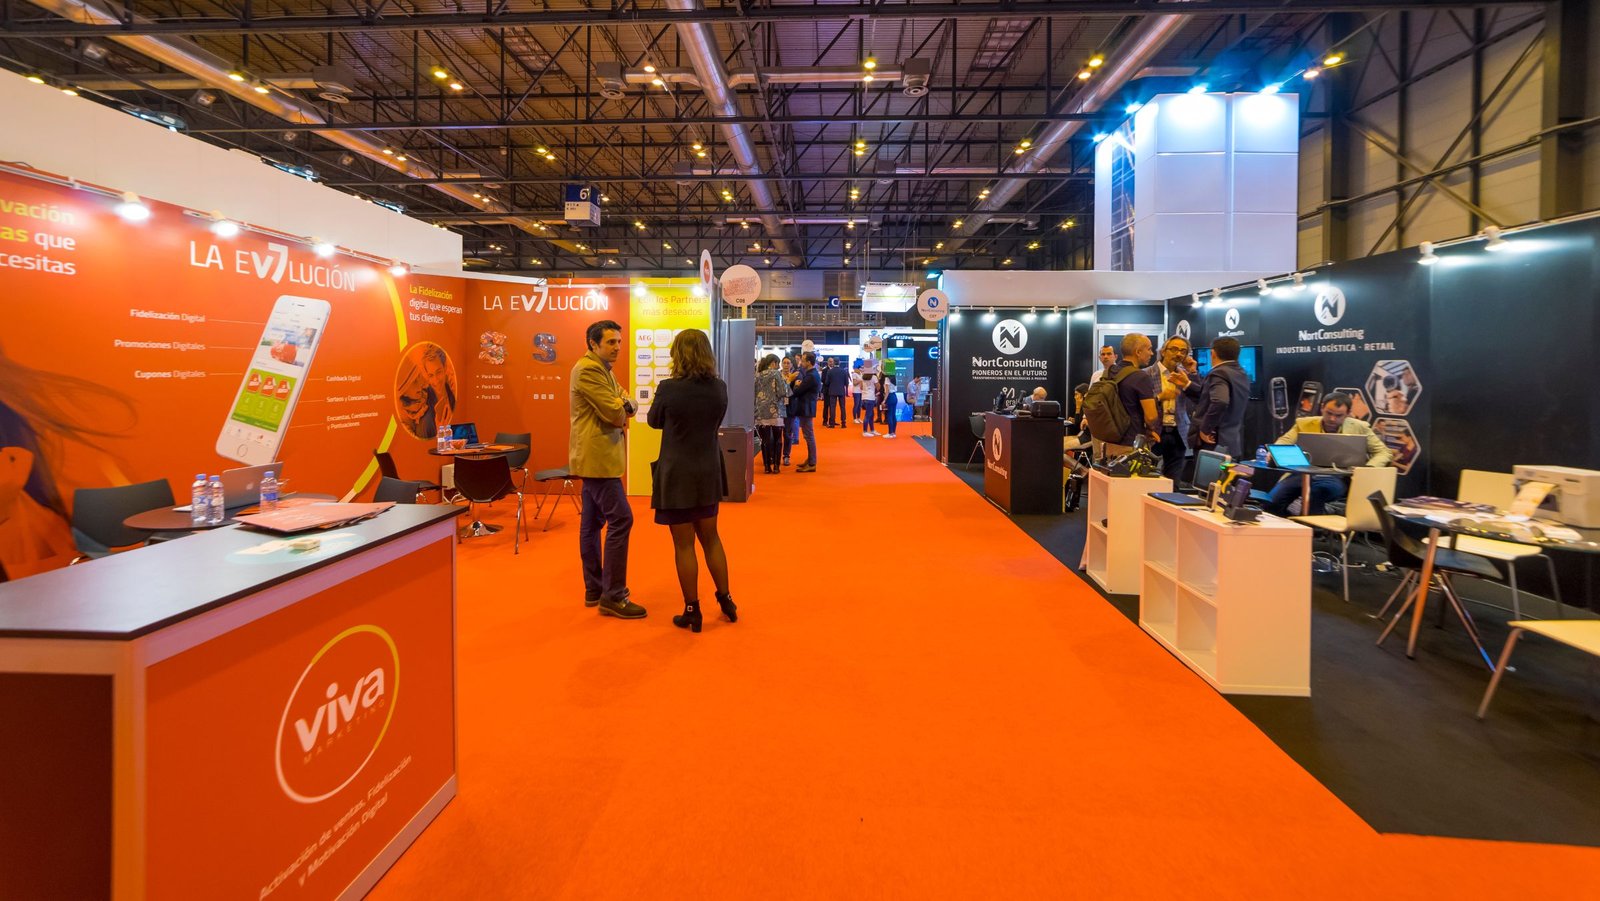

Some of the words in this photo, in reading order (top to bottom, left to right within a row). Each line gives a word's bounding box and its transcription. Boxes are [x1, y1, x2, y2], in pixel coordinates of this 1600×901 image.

[34, 232, 77, 251] que
[190, 240, 224, 270] LA
[409, 284, 418, 294] La
[419, 285, 453, 300] Fidelización
[409, 298, 429, 310] digital
[430, 303, 441, 312] que
[441, 304, 463, 314] esperan
[483, 296, 503, 311] LA
[656, 296, 669, 304] los
[130, 309, 180, 320] Fidelización
[181, 313, 205, 324] Digital
[409, 311, 420, 321] tus
[421, 313, 445, 324] clientes
[662, 308, 703, 316] deseados
[1298, 328, 1365, 341] NortConsulting
[114, 339, 172, 349] Promociones
[173, 341, 206, 351] Digitales
[1276, 346, 1312, 354] INDUSTRIA
[1317, 342, 1357, 353] LOGÍSTICA
[1364, 342, 1396, 351] RETAIL
[972, 356, 1048, 370] NortConsulting
[134, 370, 172, 380] Cupones
[173, 370, 206, 380] Digitales
[987, 458, 1008, 480] NortConsulting
[294, 667, 385, 752] viva
[303, 699, 385, 765] MARKETING
[259, 843, 318, 901] Activación
[319, 829, 333, 846] de
[367, 755, 412, 801] Fidelización
[307, 821, 360, 877] Motivación
[361, 791, 388, 824] Digital
